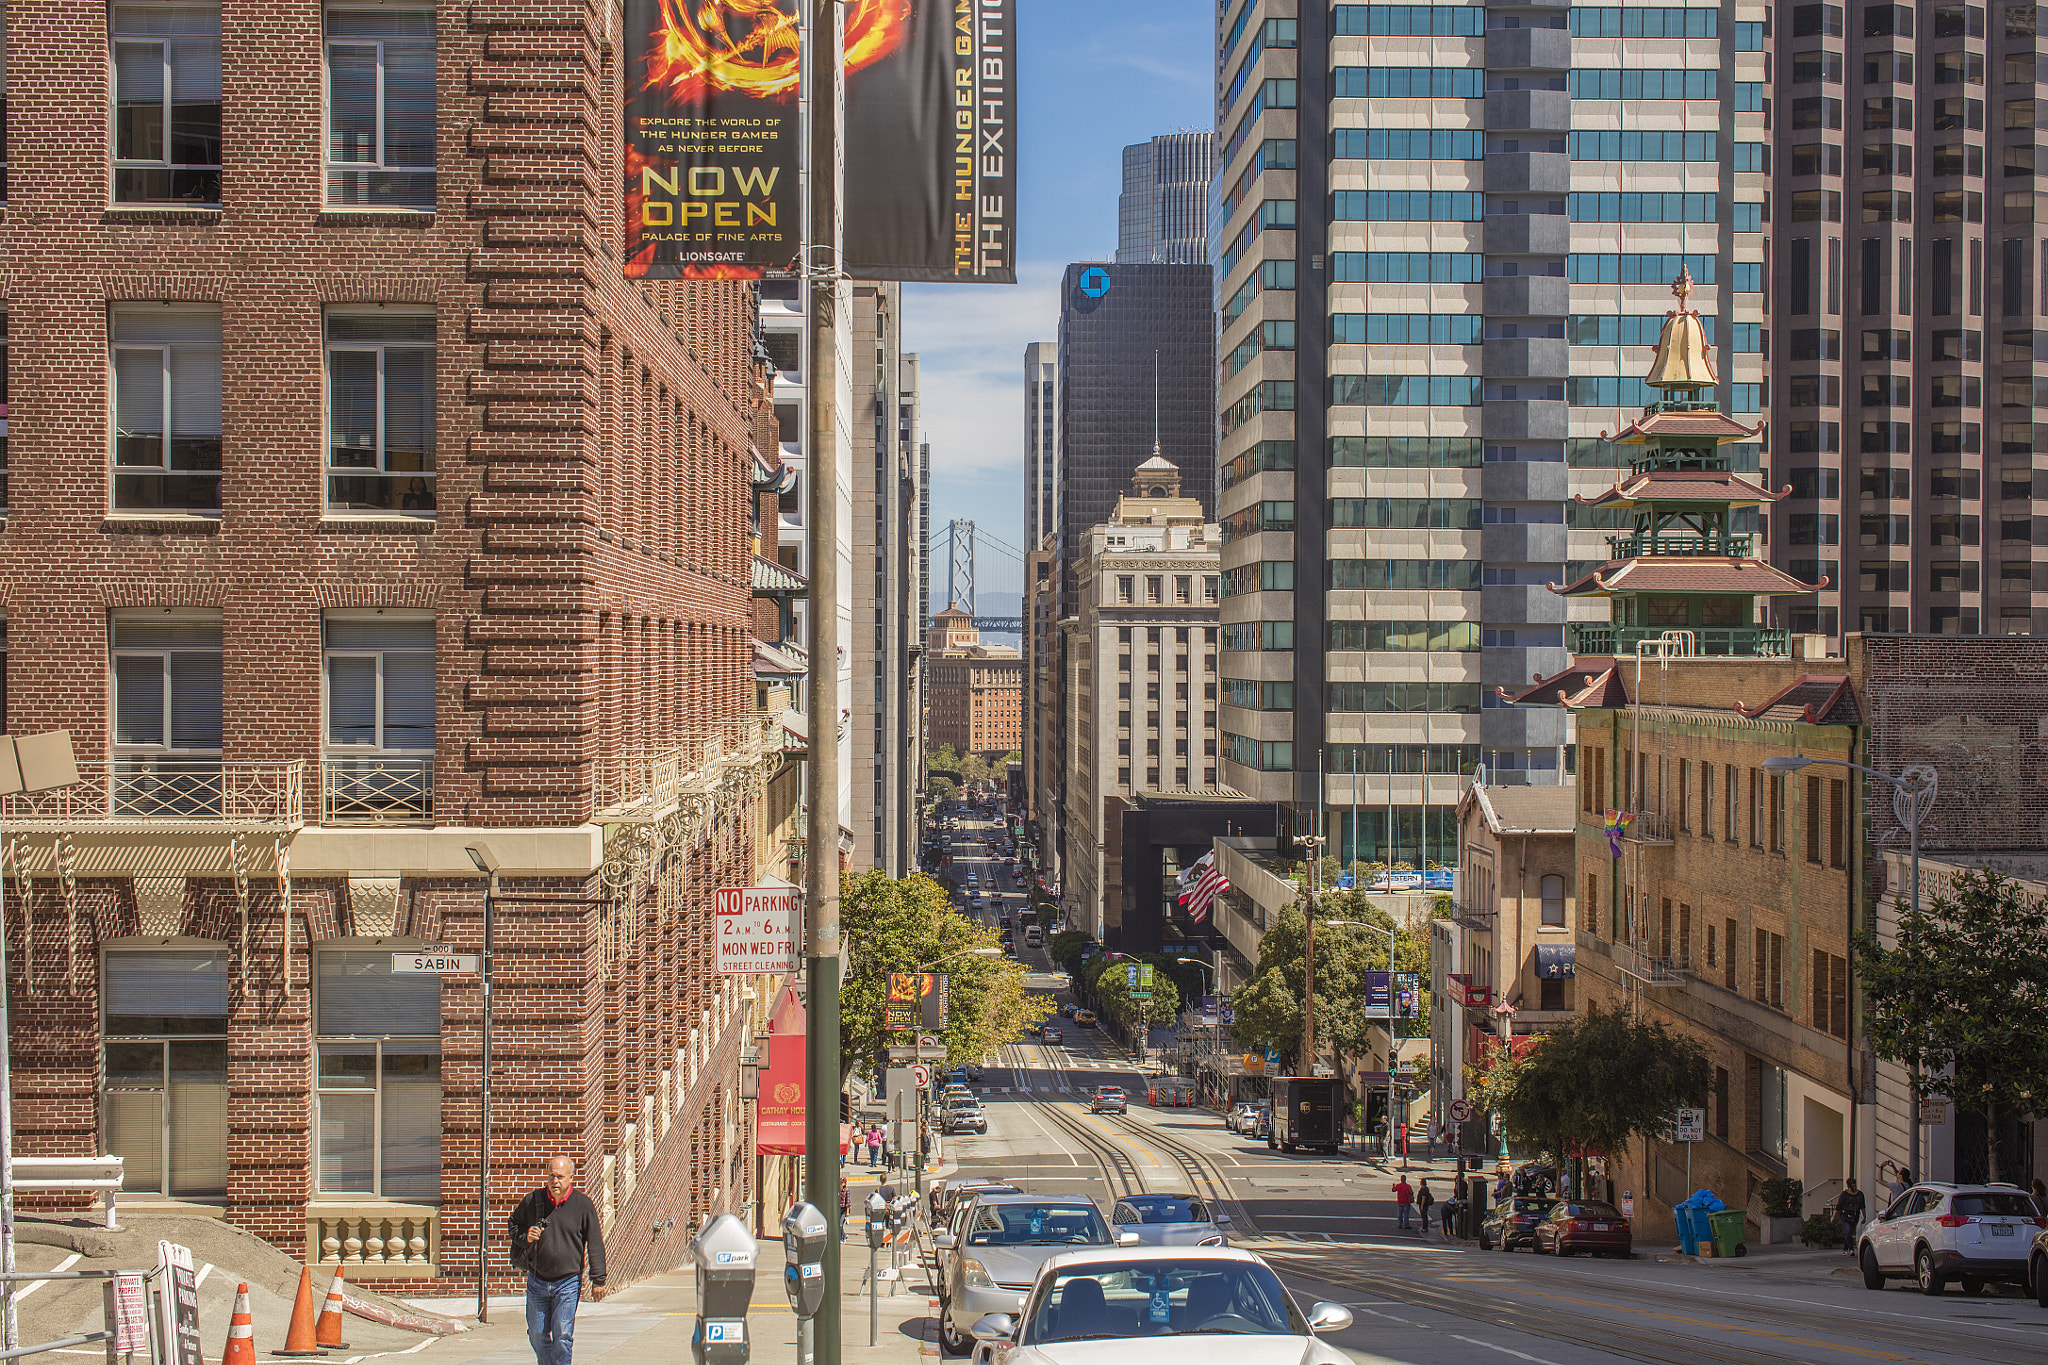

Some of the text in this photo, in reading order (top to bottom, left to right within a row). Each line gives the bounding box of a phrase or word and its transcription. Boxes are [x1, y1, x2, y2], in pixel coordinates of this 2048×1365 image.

[640, 117, 781, 126] EXPLORE THE WORLD OF
[640, 130, 778, 140] THE HUNGER GAMES
[955, 66, 972, 200] HUNGER
[981, 0, 1004, 276] THE EXHIBITI
[658, 144, 763, 153] AS NEVER BEFORE
[642, 166, 780, 196] NOW
[642, 201, 776, 227] OPEN
[641, 233, 783, 242] PALACE OF FINE ARTS
[955, 212, 972, 275] THE
[679, 251, 745, 262] LIONSGATE
[718, 890, 798, 914] NO PARKING
[723, 918, 796, 935] 2 A.M. TO 6 A.M.
[432, 945, 449, 953] 000
[722, 941, 795, 956] MON WED FRI
[414, 958, 460, 970] SABIN
[722, 960, 794, 971] STREET CLEANING
[761, 1106, 788, 1115] CATHAY
[120, 1278, 140, 1286] PRIVATE
